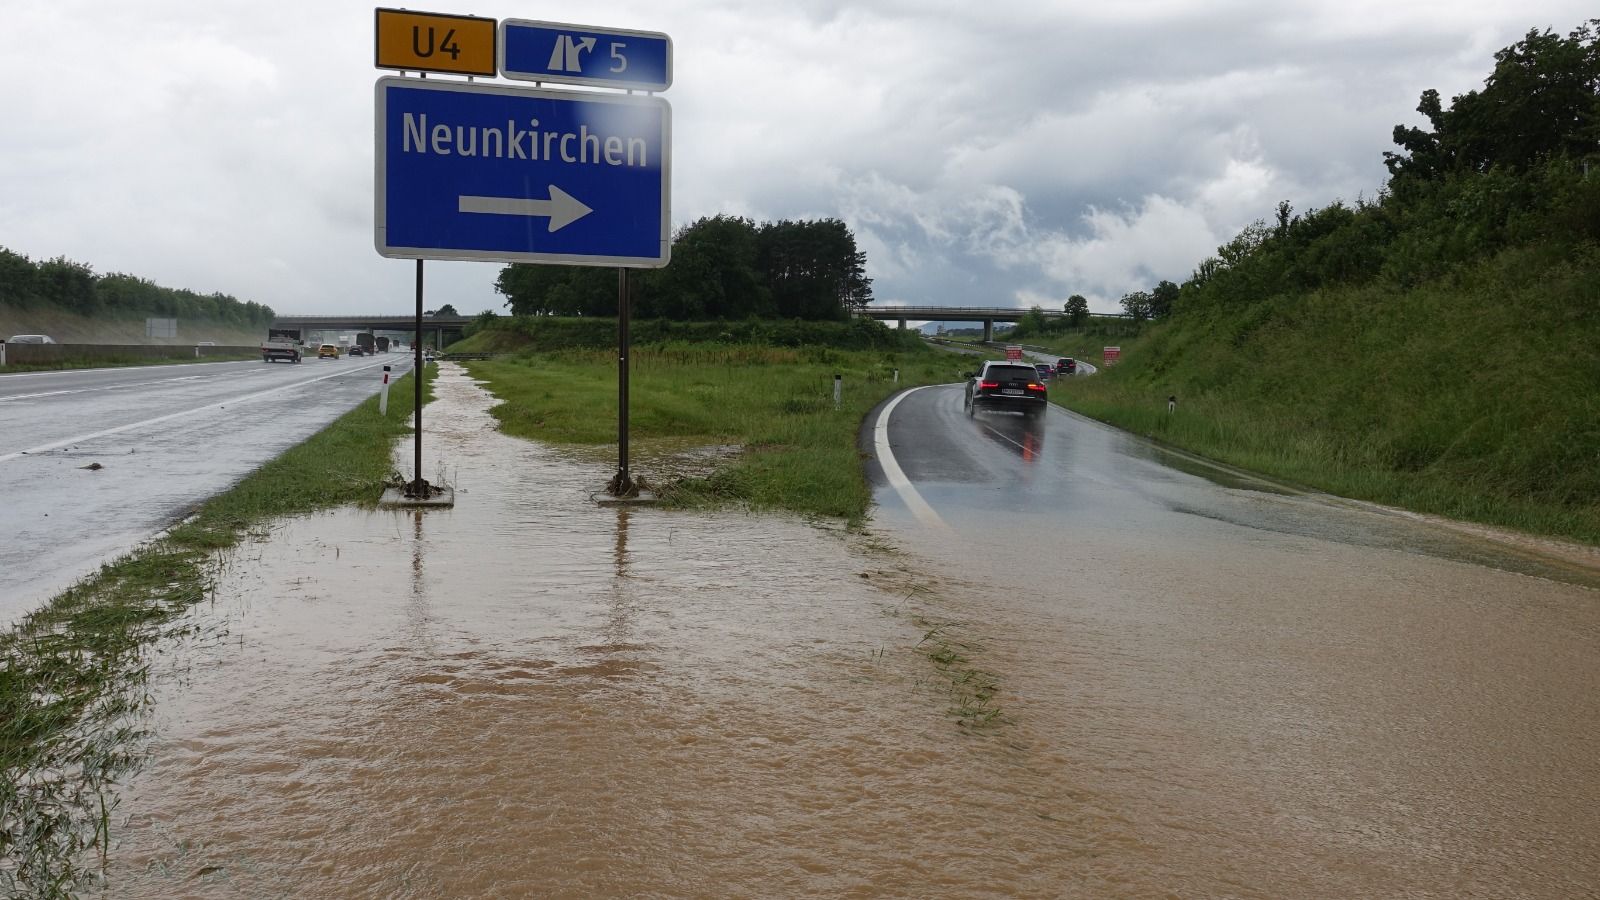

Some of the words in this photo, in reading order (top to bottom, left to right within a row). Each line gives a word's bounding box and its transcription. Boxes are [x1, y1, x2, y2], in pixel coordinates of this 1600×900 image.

[412, 25, 461, 61] U4
[609, 42, 628, 74] 5
[403, 112, 647, 167] Neunkirchen
